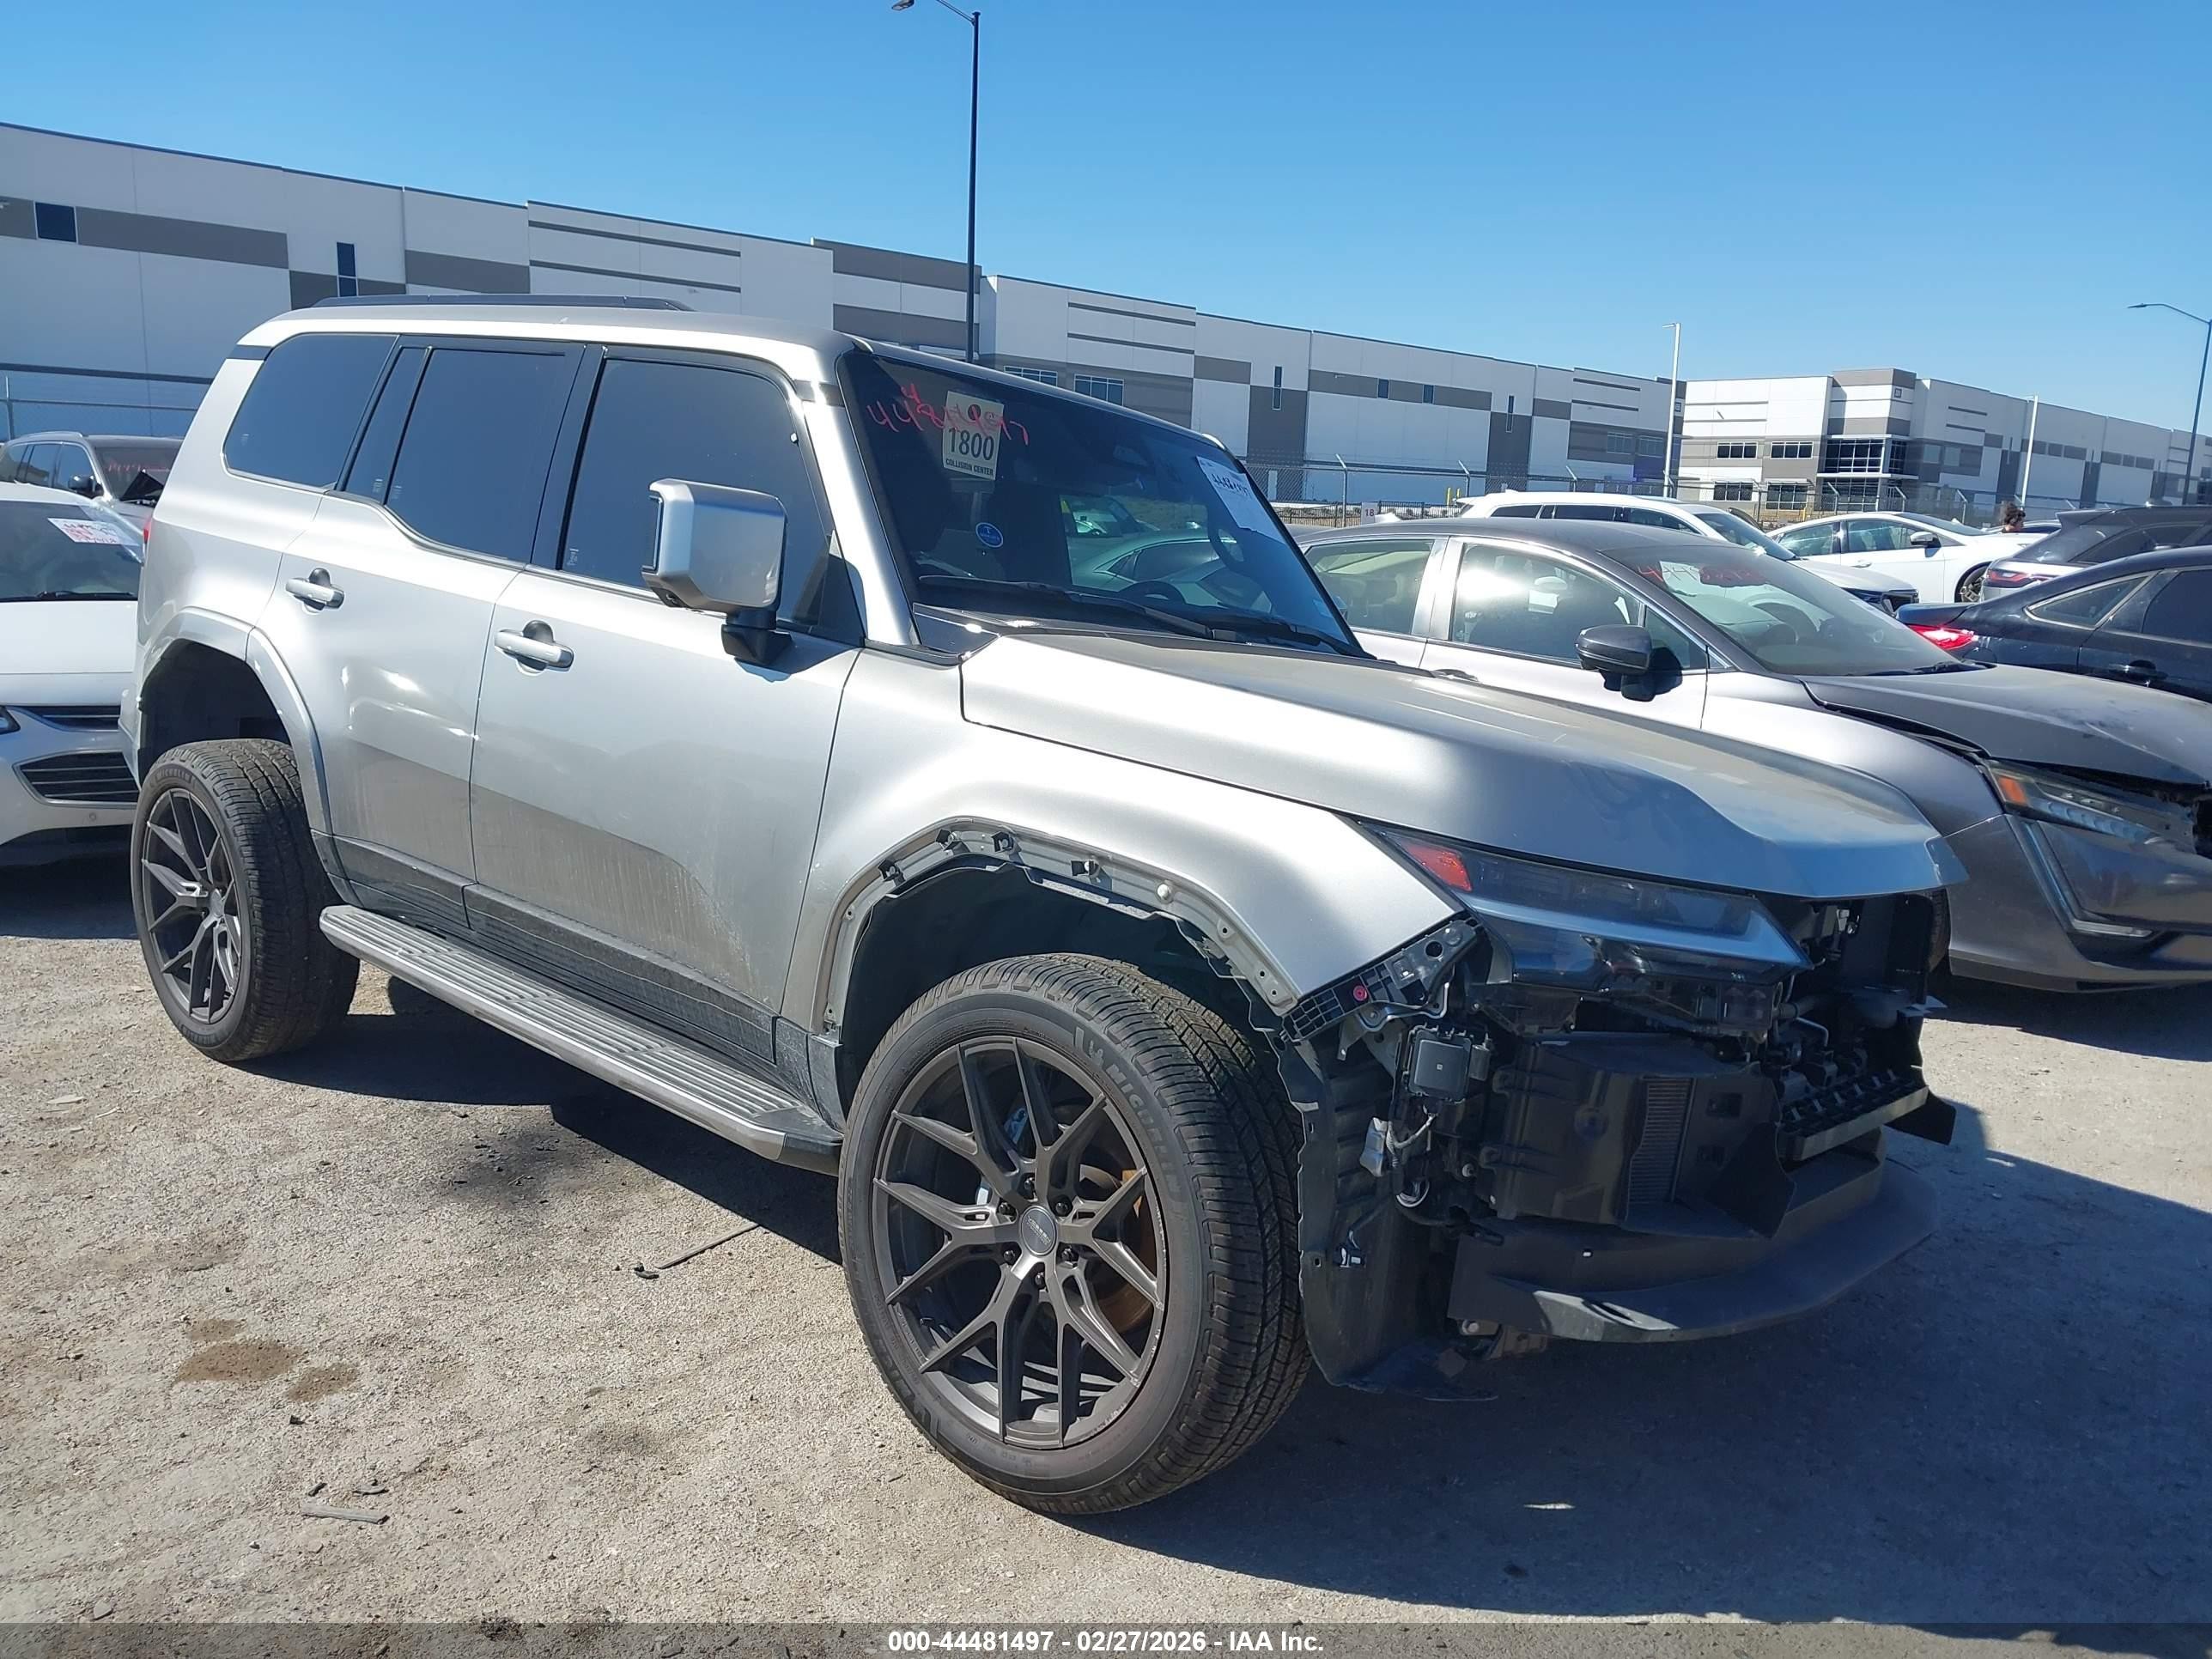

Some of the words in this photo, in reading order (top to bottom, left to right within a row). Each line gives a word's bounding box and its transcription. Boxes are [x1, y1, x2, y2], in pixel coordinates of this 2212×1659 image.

[948, 428, 994, 461] 1800
[945, 458, 973, 472] COLLISION
[973, 465, 994, 477] CENTER
[1364, 507, 1375, 517] 18
